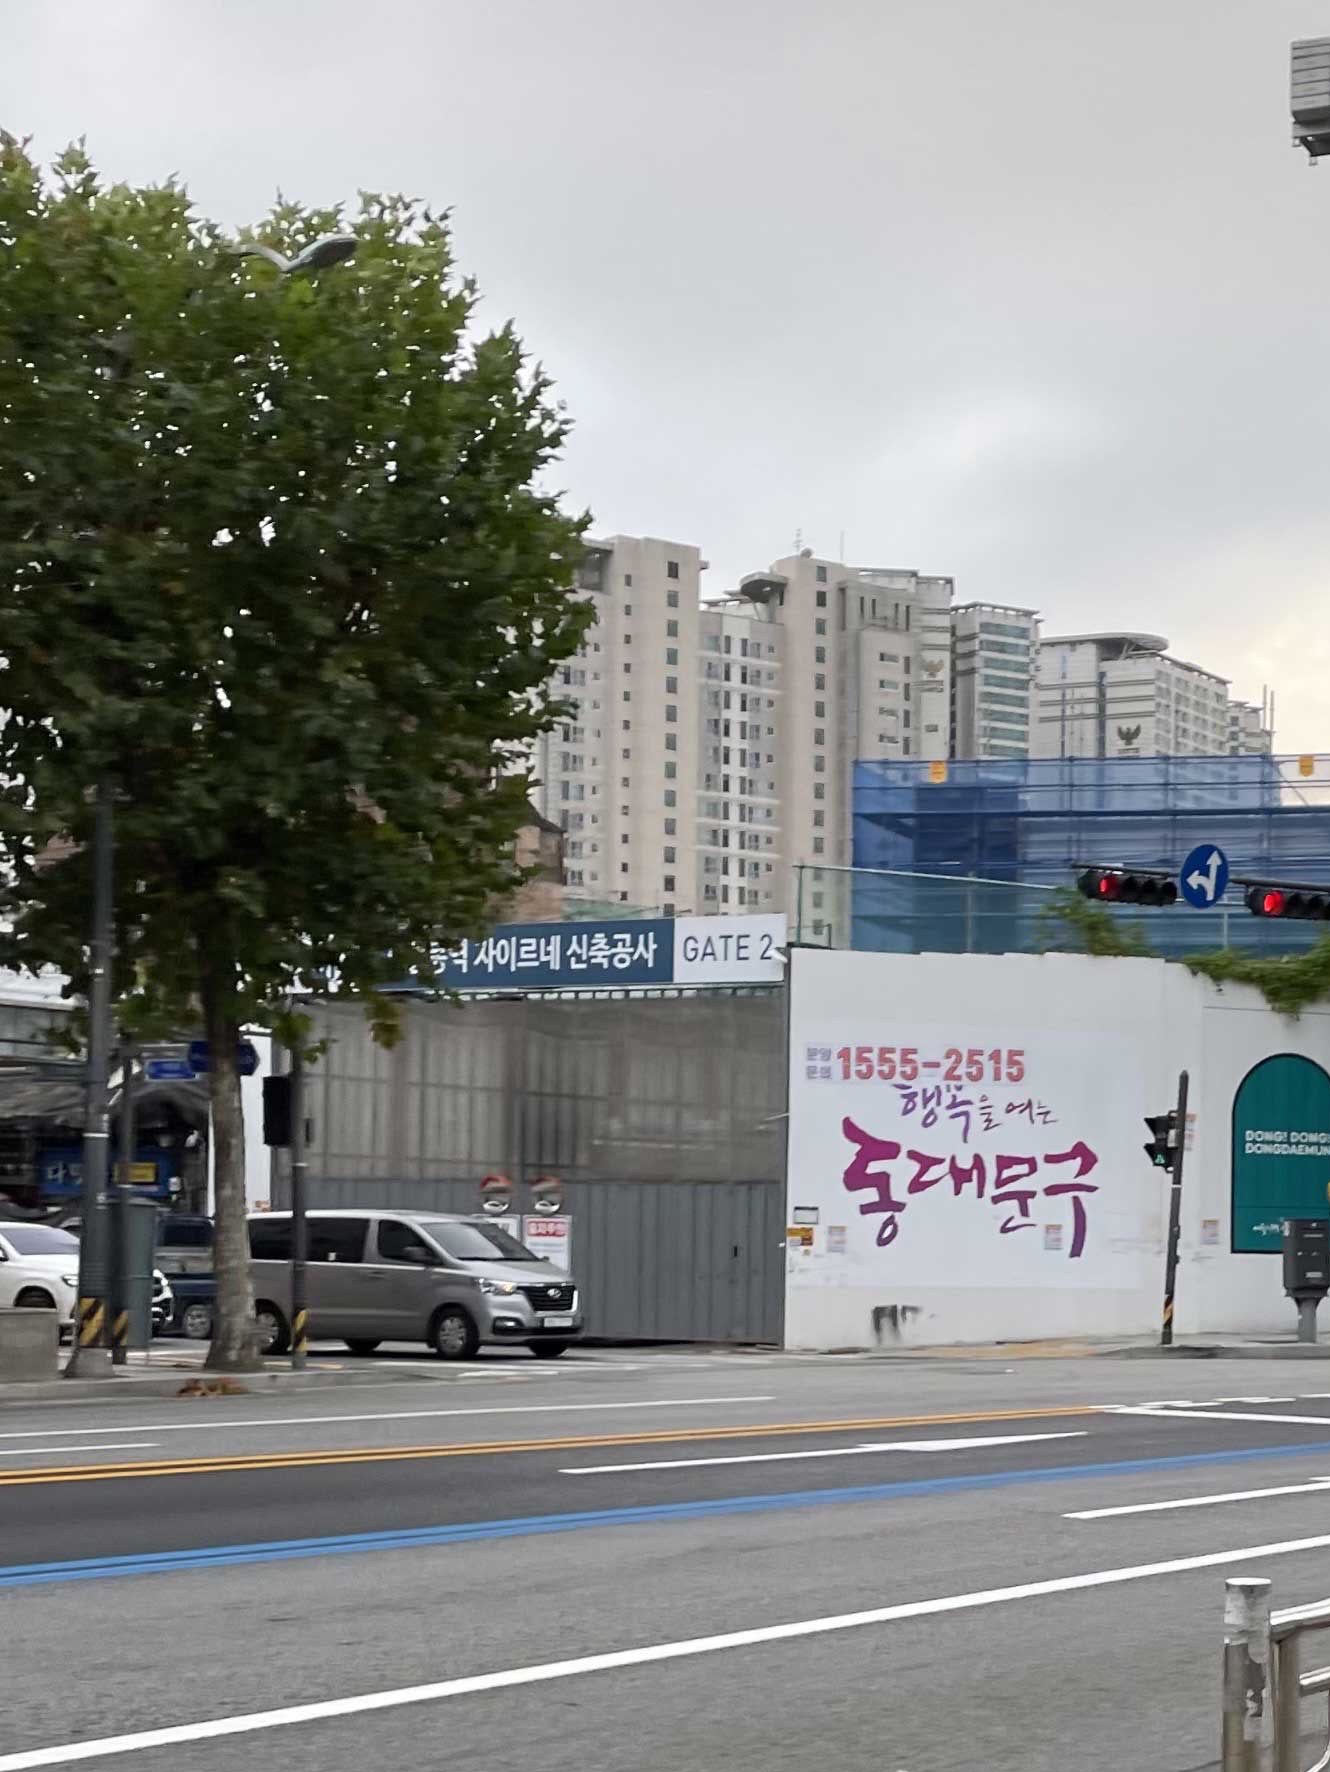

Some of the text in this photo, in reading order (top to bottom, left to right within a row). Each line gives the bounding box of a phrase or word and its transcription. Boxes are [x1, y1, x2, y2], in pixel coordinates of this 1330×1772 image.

[473, 934, 561, 974] 자이르네
[566, 931, 657, 969] 신축공사
[683, 933, 773, 962] GATE 2
[836, 1046, 1025, 1082] 1555-2515
[1005, 1098, 1059, 1125] 여는
[1245, 1130, 1288, 1142] DONG!
[842, 1116, 1100, 1259] 동대문구
